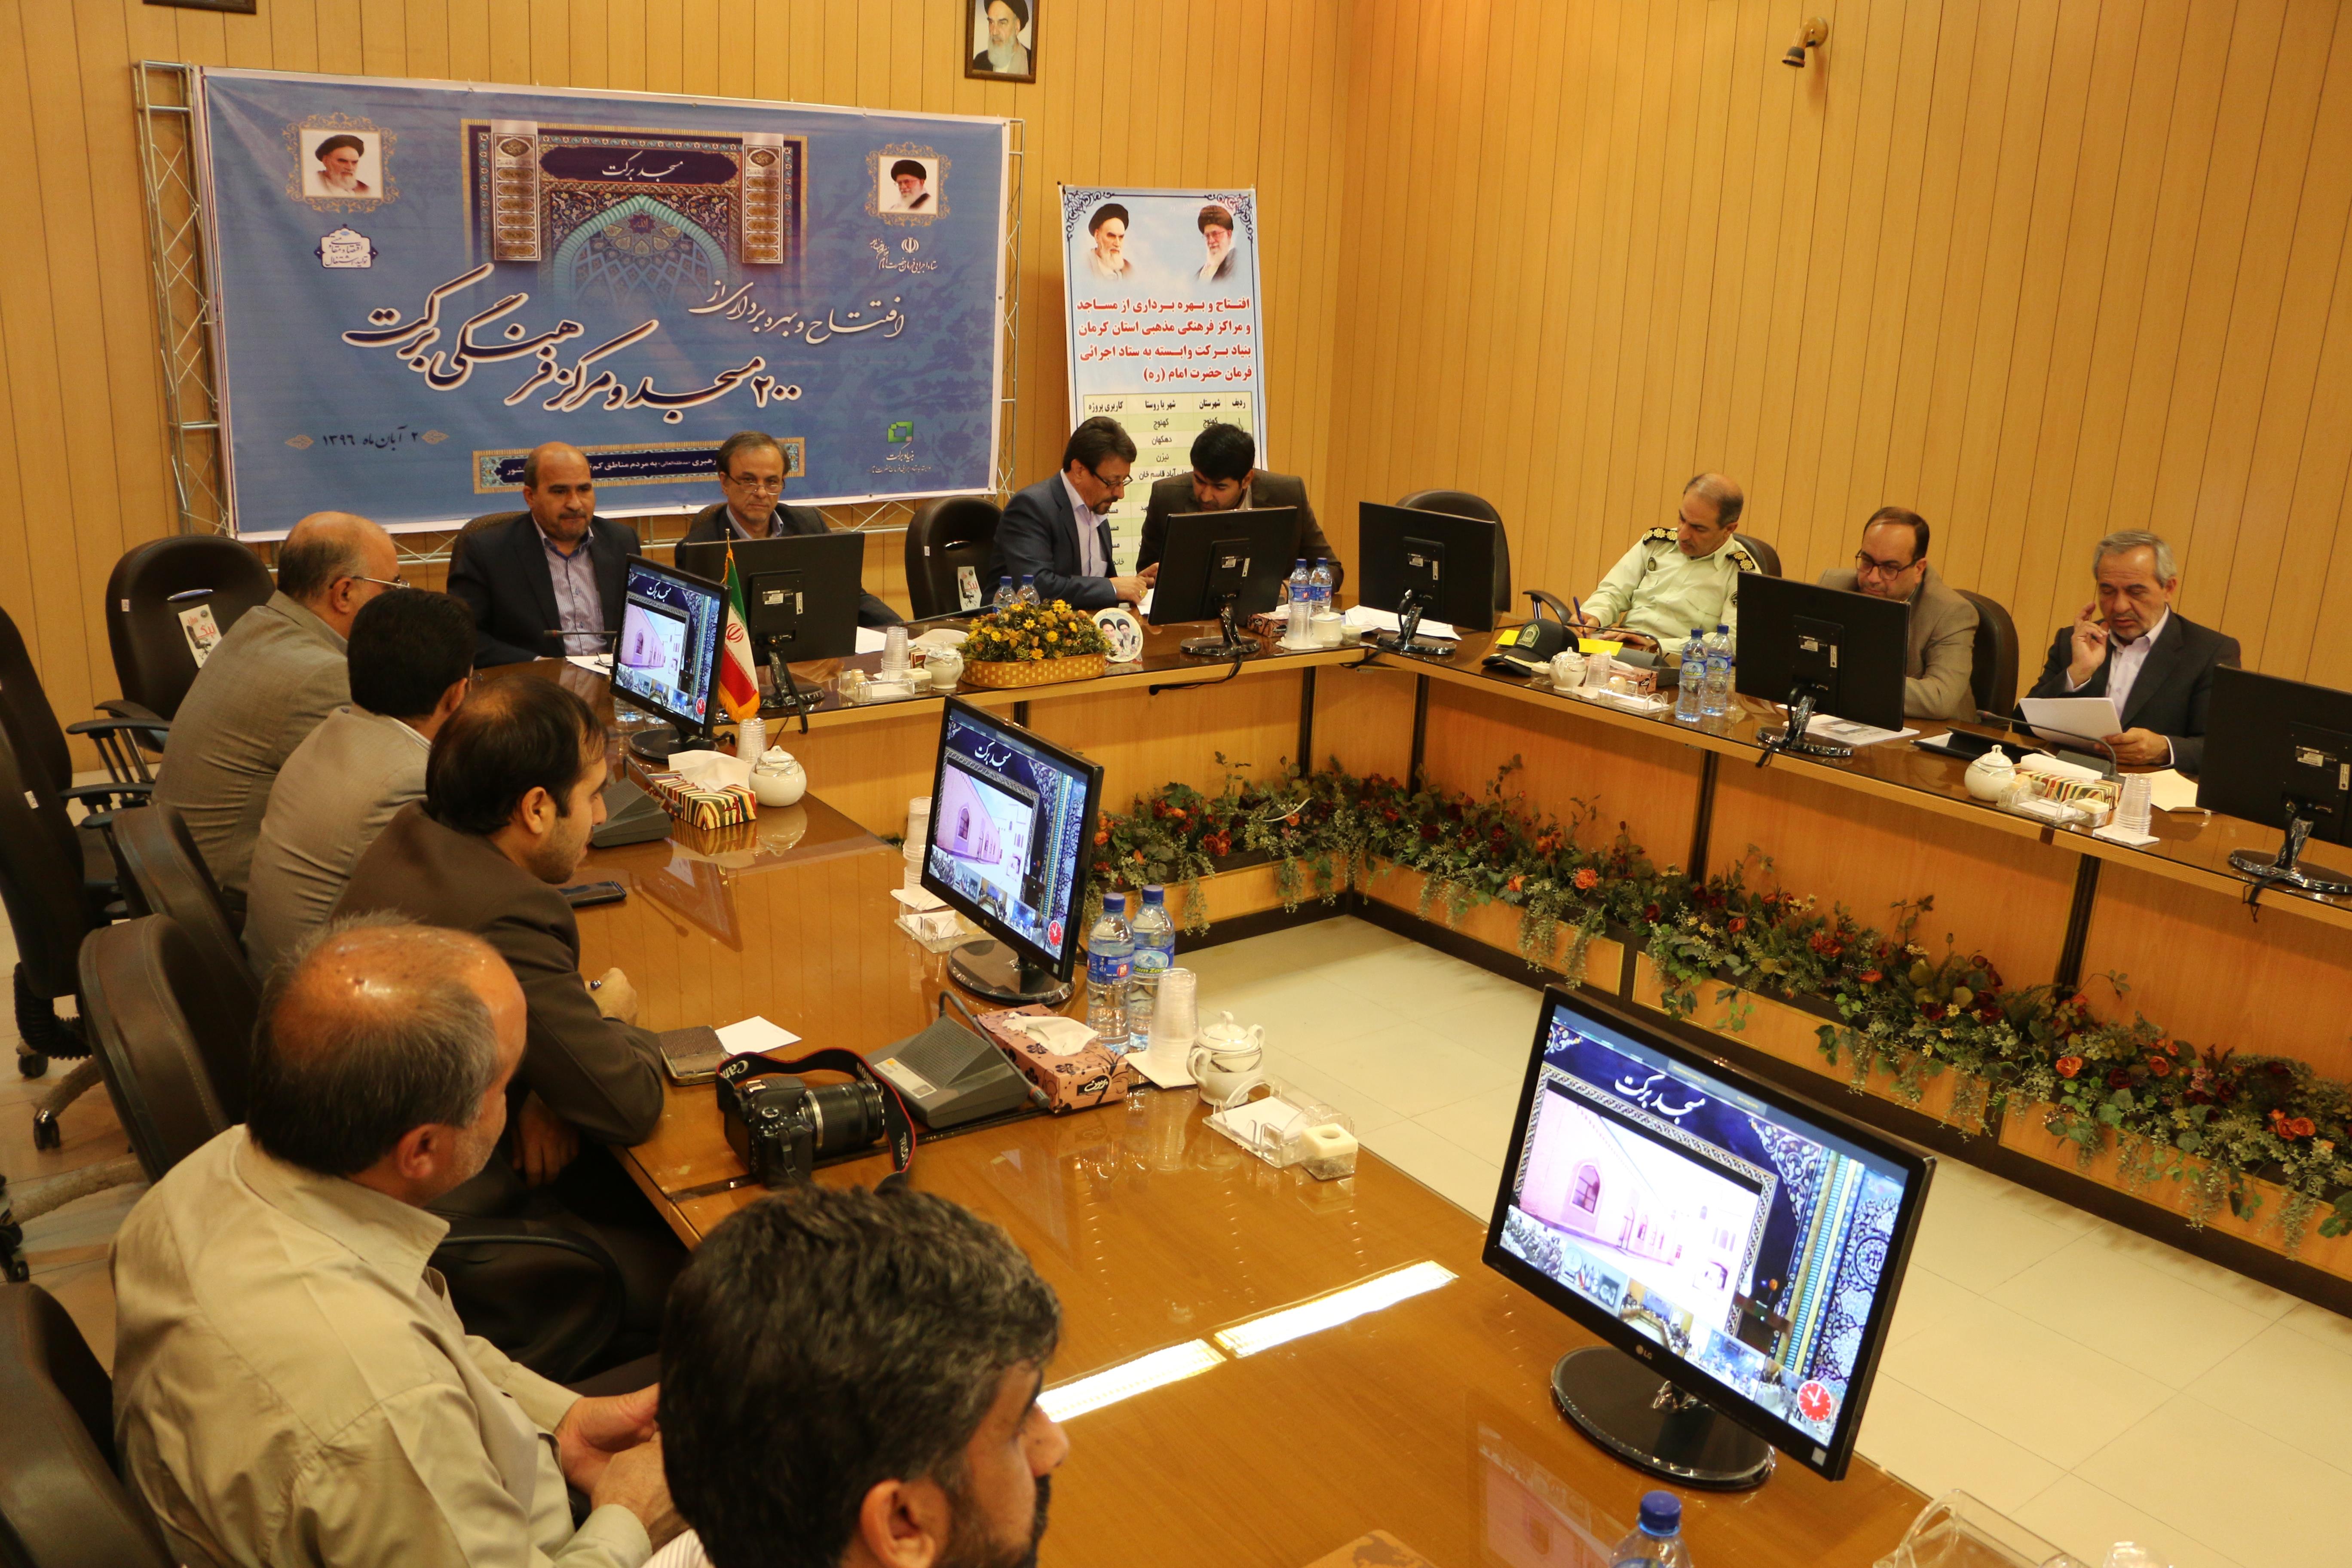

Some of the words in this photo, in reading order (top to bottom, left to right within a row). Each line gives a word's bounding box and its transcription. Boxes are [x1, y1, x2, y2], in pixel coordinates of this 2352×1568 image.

[602, 151, 643, 181] برکت
[640, 160, 684, 182] مسجد
[1077, 298, 1118, 312] مساجد
[1121, 298, 1129, 313] از
[1178, 300, 1205, 312] بهره
[1208, 304, 1213, 312] و
[1216, 298, 1250, 312] افتتاح
[342, 263, 494, 373] برکت
[806, 296, 905, 344] افتتاح
[795, 321, 804, 333] و
[1078, 321, 1108, 336] کرمان
[1112, 322, 1139, 335] استان
[1142, 321, 1174, 334] مذهبی
[1178, 320, 1213, 334] فرهنگی
[1217, 320, 1243, 334] مراکز
[1246, 326, 1250, 334] و
[425, 293, 584, 406] فرهنگی
[1080, 345, 1115, 361] اجرائی
[1118, 346, 1139, 357] ستاد
[1143, 349, 1152, 359] به
[1155, 345, 1192, 359] وابسته
[1195, 345, 1228, 359] برکت
[1231, 345, 1251, 358] بنیاد
[543, 319, 659, 412] مرکز
[1143, 368, 1165, 383] (ره)
[1168, 367, 1187, 382] امام
[1190, 368, 1222, 381] حضرت
[1225, 366, 1252, 381] فرمان
[603, 383, 627, 411] و
[624, 356, 766, 424] مسجد
[750, 375, 802, 408] ۲۰۰
[1088, 404, 1103, 412] پروژه
[1105, 401, 1123, 412] کاربری
[1145, 400, 1159, 410] روستا
[1166, 400, 1176, 408] شهر
[1199, 399, 1220, 409] شهرستان
[1154, 419, 1169, 429] کهنوج
[323, 434, 355, 446] ۱۳۹۶
[1152, 436, 1172, 445] دهکهان
[604, 461, 629, 470] مناطق
[692, 458, 716, 466] رهبری
[1139, 471, 1148, 480] خان
[1151, 470, 1164, 480] قاسم
[656, 587, 671, 602] مسجد
[989, 752, 1011, 772] مسجد
[720, 1060, 749, 1078] Can
[1615, 1074, 1666, 1109] برکت
[1650, 1093, 1706, 1125] مسجد
[1644, 1350, 1652, 1360] LG
